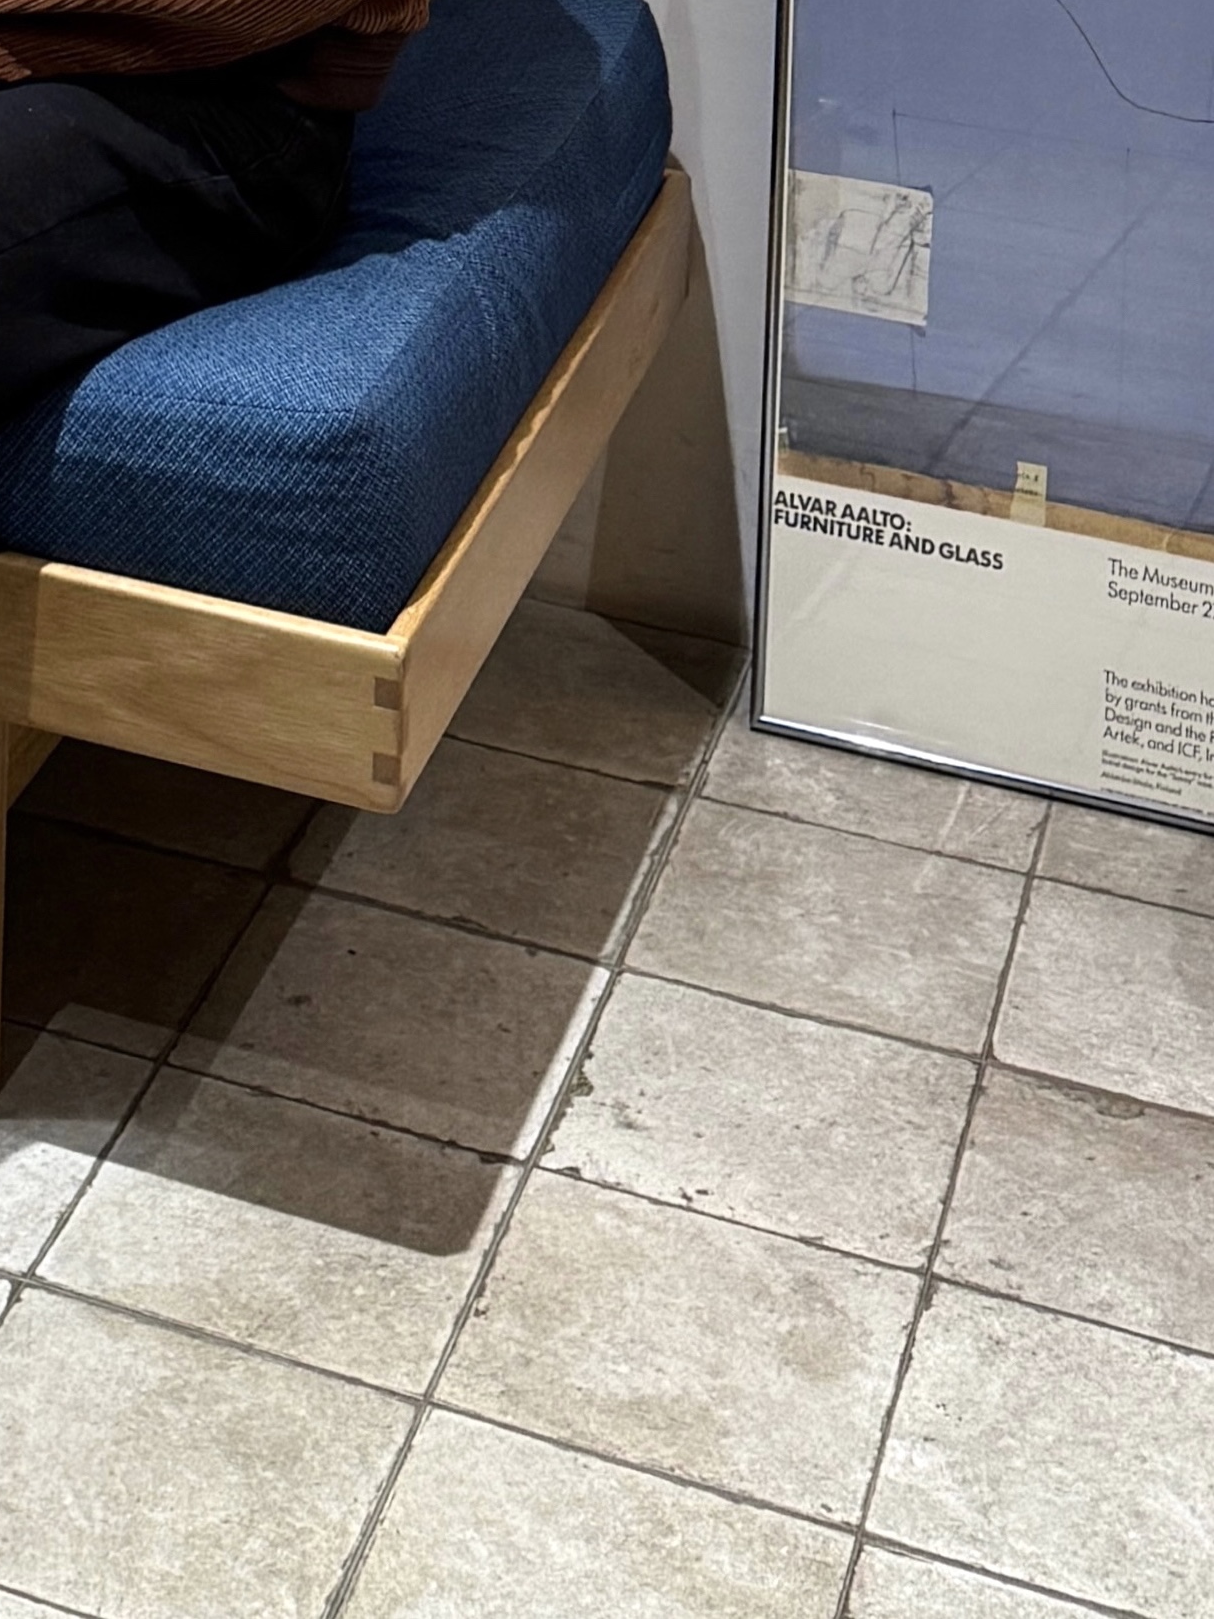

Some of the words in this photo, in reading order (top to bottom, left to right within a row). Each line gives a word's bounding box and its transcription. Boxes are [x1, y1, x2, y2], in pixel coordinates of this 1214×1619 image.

[774, 490, 837, 517] ALVAR
[841, 504, 912, 532] AALTO:
[774, 509, 885, 545] FURNITURE
[889, 532, 935, 555] AND
[939, 542, 1004, 570] GLASS
[1108, 557, 1139, 580] The
[1142, 565, 1214, 596] Museum
[1108, 580, 1199, 615] September
[1103, 669, 1128, 688] The
[1131, 678, 1197, 703] exhibition
[1105, 687, 1122, 707] by
[1124, 697, 1167, 715] grants
[1171, 702, 1203, 723] from
[1104, 706, 1152, 732] Design
[1155, 722, 1182, 737] and
[1185, 725, 1206, 742] the
[1103, 725, 1144, 748] Artek,
[1147, 739, 1175, 754] and
[1177, 741, 1202, 762] ICF,
